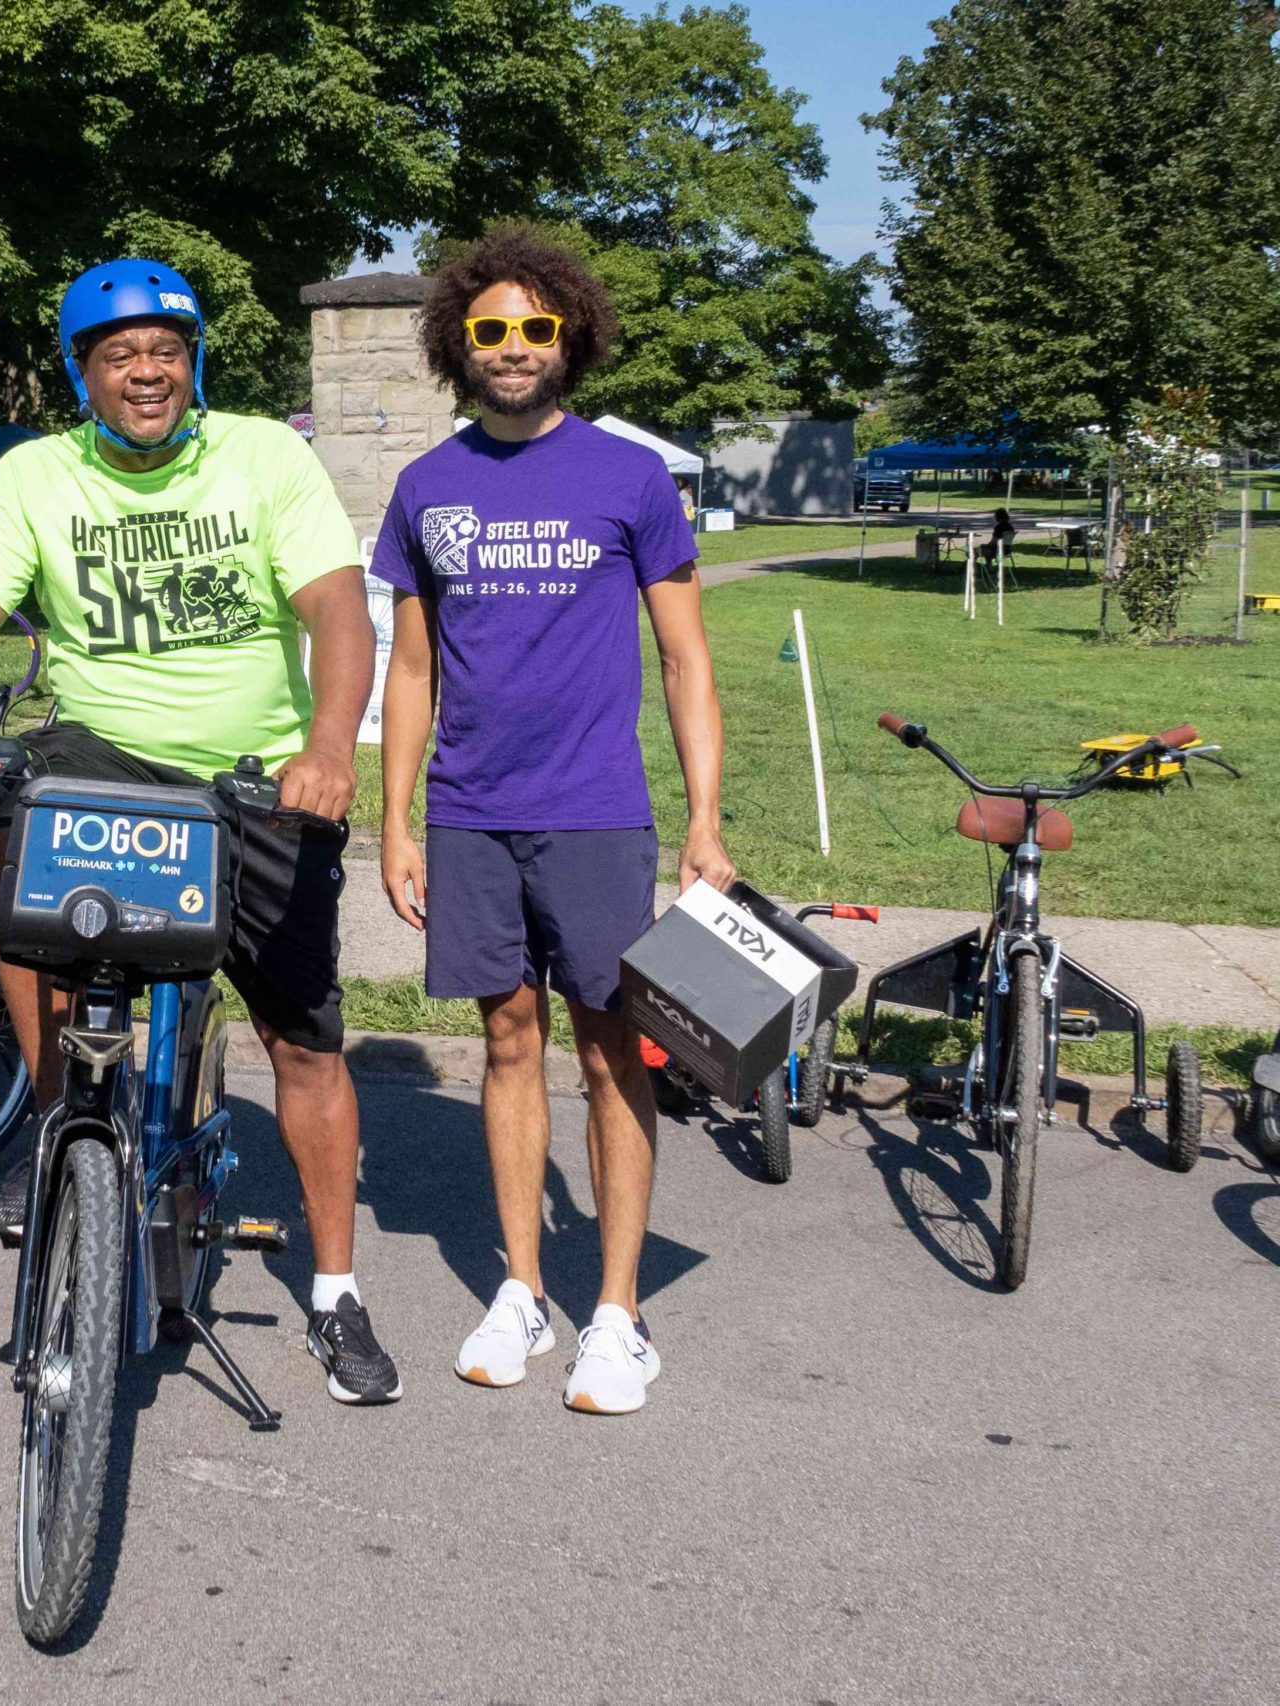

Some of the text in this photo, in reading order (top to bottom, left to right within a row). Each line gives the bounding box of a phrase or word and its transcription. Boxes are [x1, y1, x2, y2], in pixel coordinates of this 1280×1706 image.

[135, 512, 169, 524] 2022
[486, 520, 570, 540] STEEL CITY
[477, 538, 601, 569] WORLD CUP
[480, 582, 531, 595] 25-26,
[538, 582, 577, 595] 2022
[76, 555, 162, 655] 5K
[52, 811, 189, 861] POGOH
[52, 855, 180, 876] HIGHMARK AHN
[714, 911, 777, 962] KALI
[647, 988, 711, 1048] KALI
